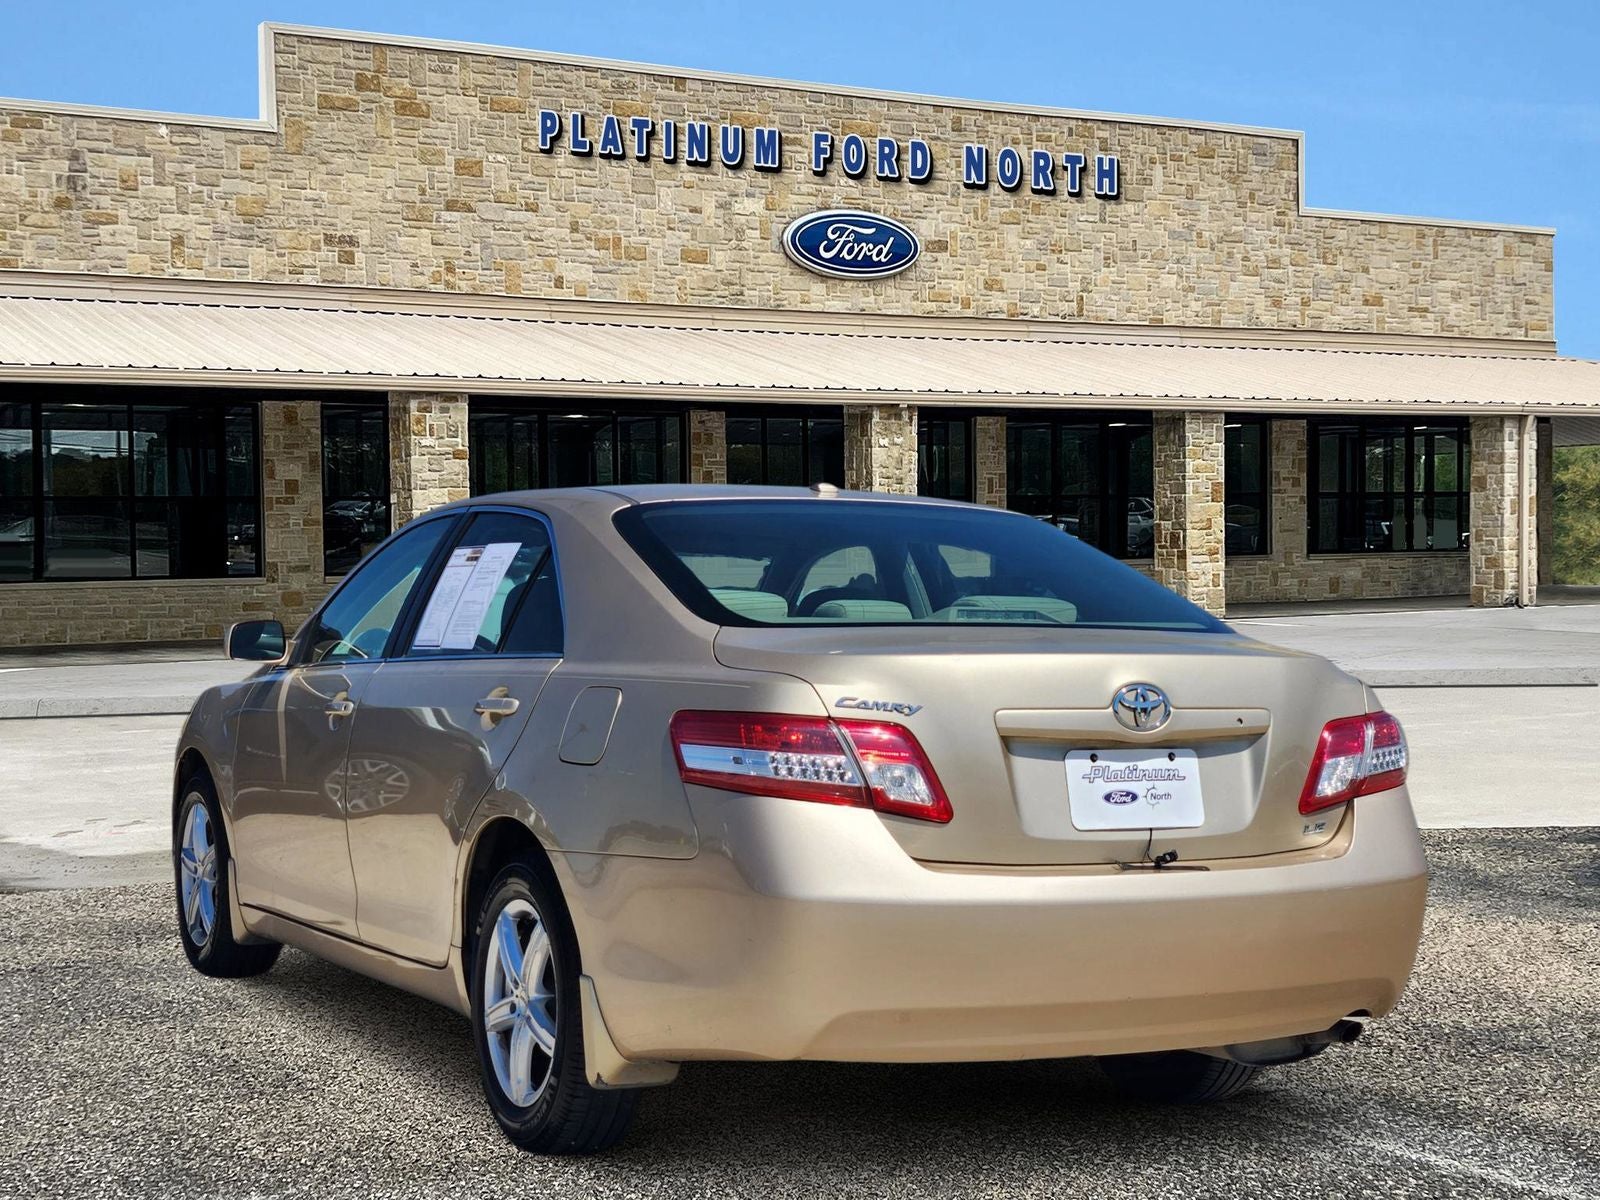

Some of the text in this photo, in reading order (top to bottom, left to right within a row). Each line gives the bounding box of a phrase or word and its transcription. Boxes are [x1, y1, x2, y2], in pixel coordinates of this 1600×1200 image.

[538, 109, 1121, 197] PLATINUM FORD NORTH
[818, 222, 894, 265] Ford
[834, 696, 924, 717] CAMRY
[1082, 763, 1186, 784] Platinum
[1109, 791, 1172, 804] Ford North
